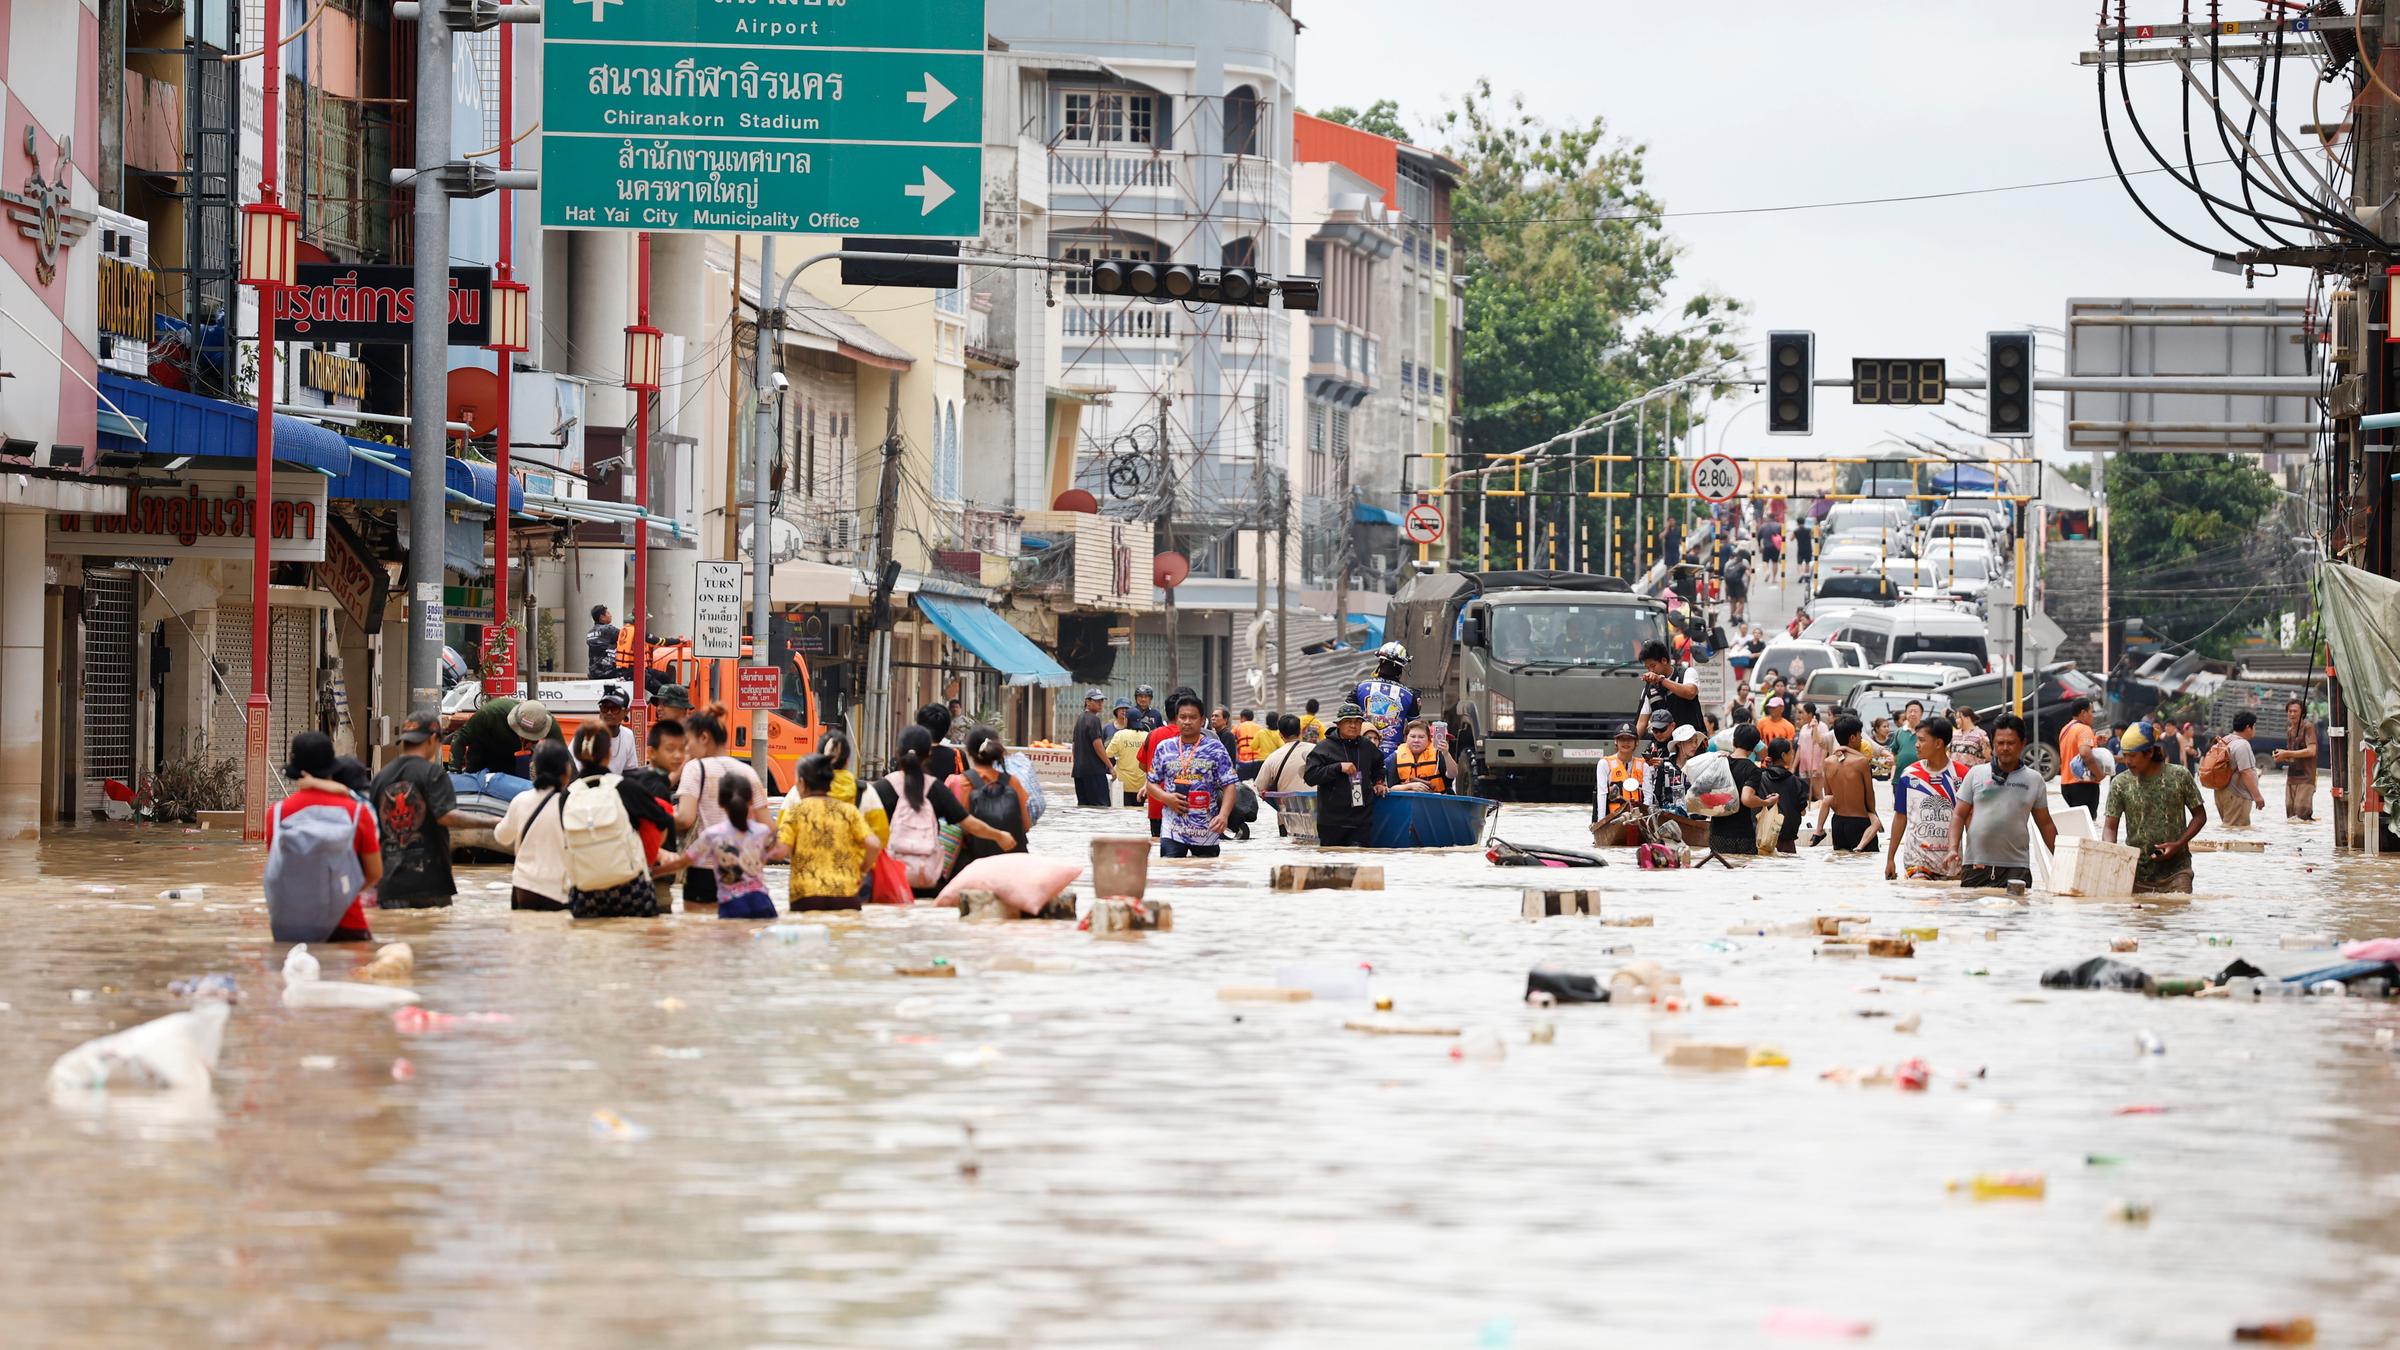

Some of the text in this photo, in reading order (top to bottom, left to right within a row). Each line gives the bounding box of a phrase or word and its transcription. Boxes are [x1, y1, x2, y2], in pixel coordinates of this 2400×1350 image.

[736, 18, 818, 37] Airport
[588, 58, 843, 101] สนามกีฬาจิรนคร
[603, 109, 819, 130] Chiranakorn Stadium
[618, 139, 811, 174] สำนักงานเทศบาล
[616, 172, 759, 209] นครหาดใหญ่
[565, 206, 860, 230] Hat Yai City Municipality Office
[712, 565, 728, 575] NO
[704, 578, 734, 588] TURN
[699, 594, 739, 603] ON RED
[699, 607, 738, 622] ห้ามเลี้ยว
[708, 625, 728, 635] ขณะ
[539, 690, 564, 700] PRO
